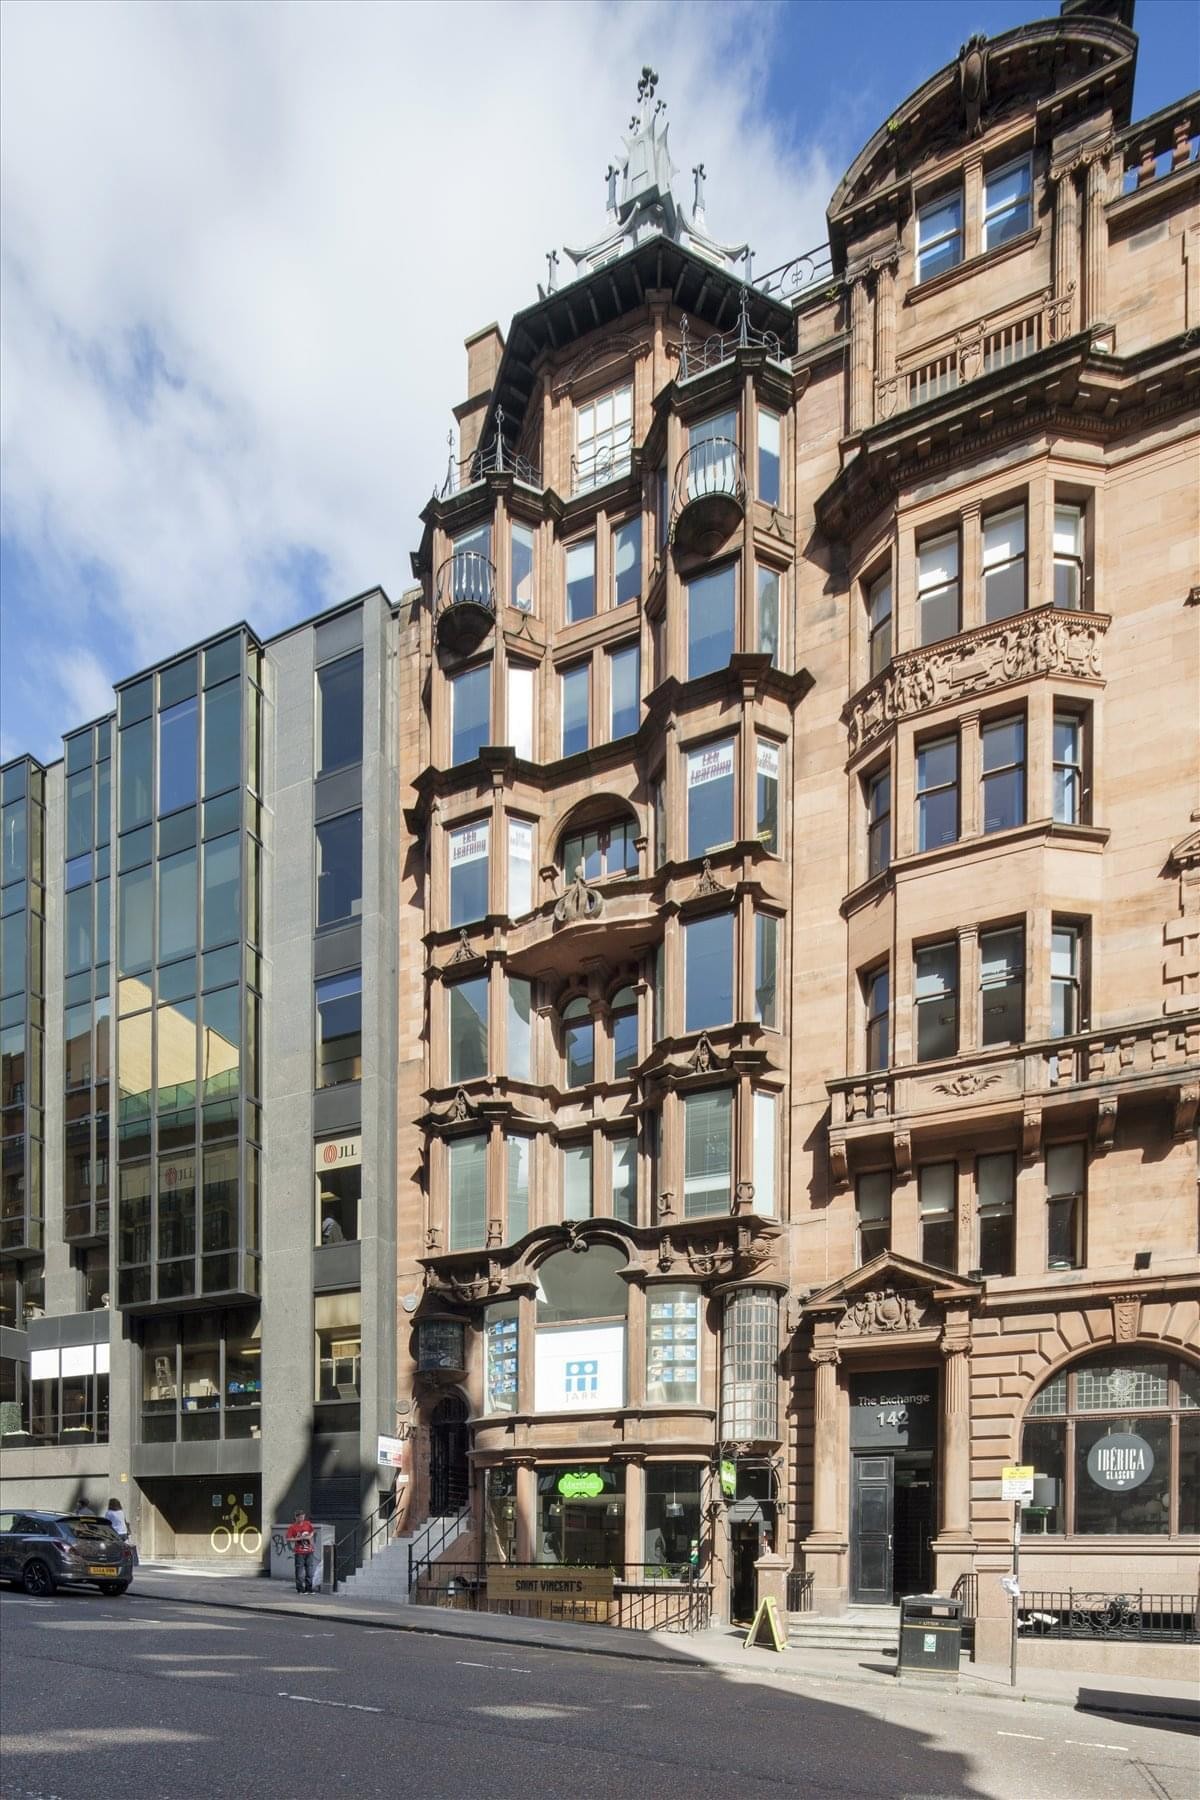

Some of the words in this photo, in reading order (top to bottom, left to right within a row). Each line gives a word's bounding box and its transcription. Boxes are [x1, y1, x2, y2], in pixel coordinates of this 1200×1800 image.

[338, 1144, 356, 1159] JLL
[179, 1163, 194, 1182] JLL
[858, 1396, 877, 1406] The
[880, 1394, 930, 1406] Exchange
[877, 1411, 909, 1426] 142
[1106, 1470, 1136, 1480] GLASGOW
[515, 1580, 538, 1592] SAINT
